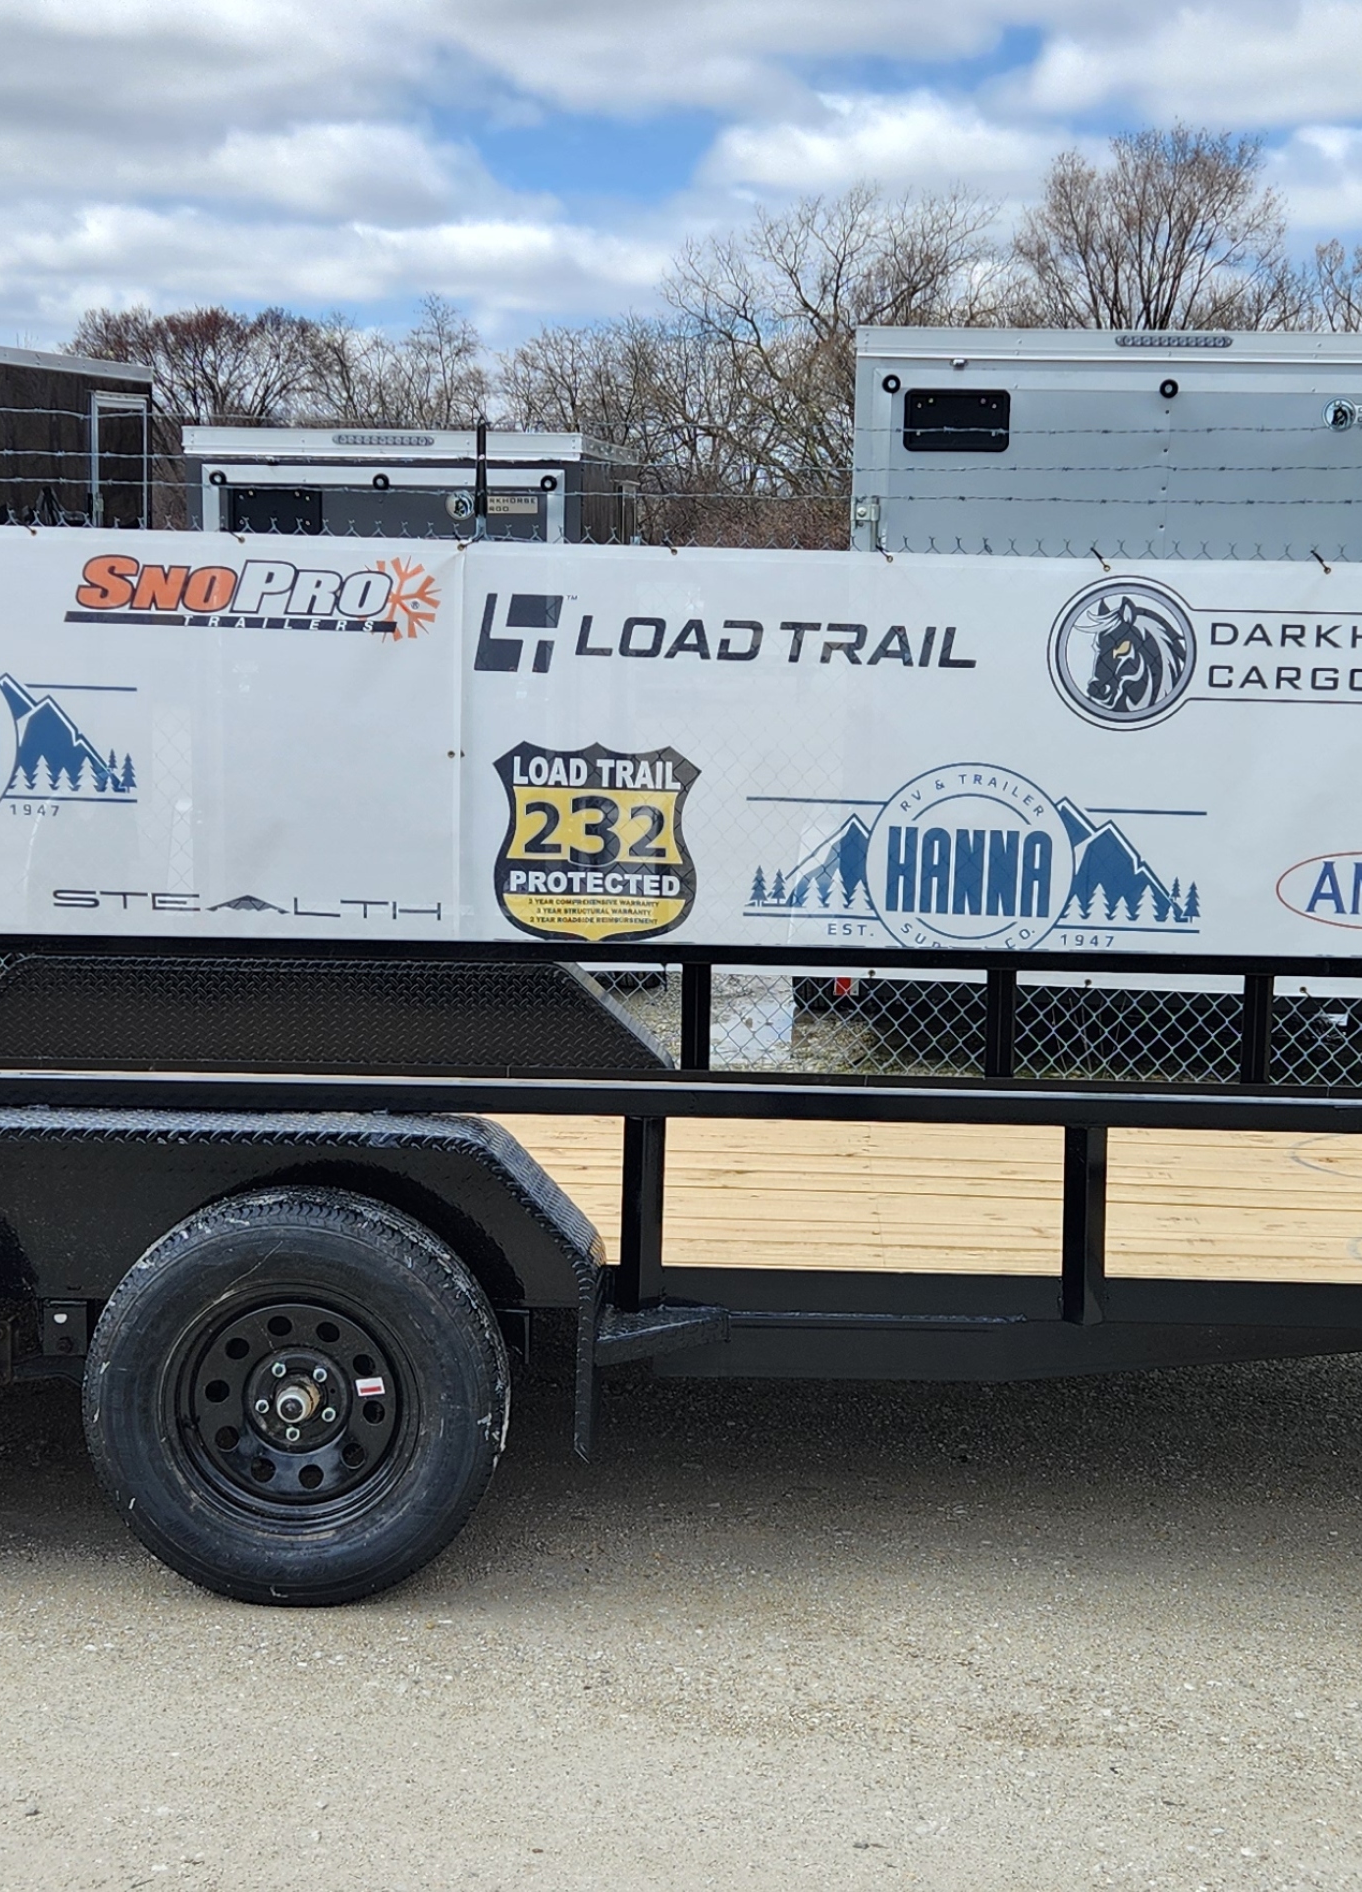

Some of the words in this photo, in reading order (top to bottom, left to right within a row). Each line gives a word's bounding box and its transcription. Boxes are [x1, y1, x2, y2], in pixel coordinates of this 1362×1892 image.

[75, 554, 394, 618] SNOPRO
[182, 614, 376, 633] TRAILERS
[574, 614, 766, 662] LOAD
[779, 621, 977, 669] TRAIL
[513, 756, 587, 787] LOAD
[596, 758, 682, 790] TRAIL
[899, 789, 923, 812] RV
[934, 779, 946, 791] &
[958, 773, 1045, 817] TRAILER
[8, 803, 61, 818] 1947
[523, 794, 667, 868] 232
[885, 825, 1053, 918] HANNA
[509, 870, 681, 898] PROTECTED
[52, 889, 442, 922] STEALTH
[535, 898, 554, 906] YEAR
[555, 898, 618, 907] COMPREHENSIVE
[619, 900, 660, 908] WARRANTY
[543, 907, 563, 915] YEAR
[611, 908, 652, 916] WARRANTY
[597, 917, 659, 925] REIMBURSEMENT
[827, 922, 875, 937] EST.
[1004, 928, 1036, 949] CO.
[1060, 933, 1115, 948] 1947
